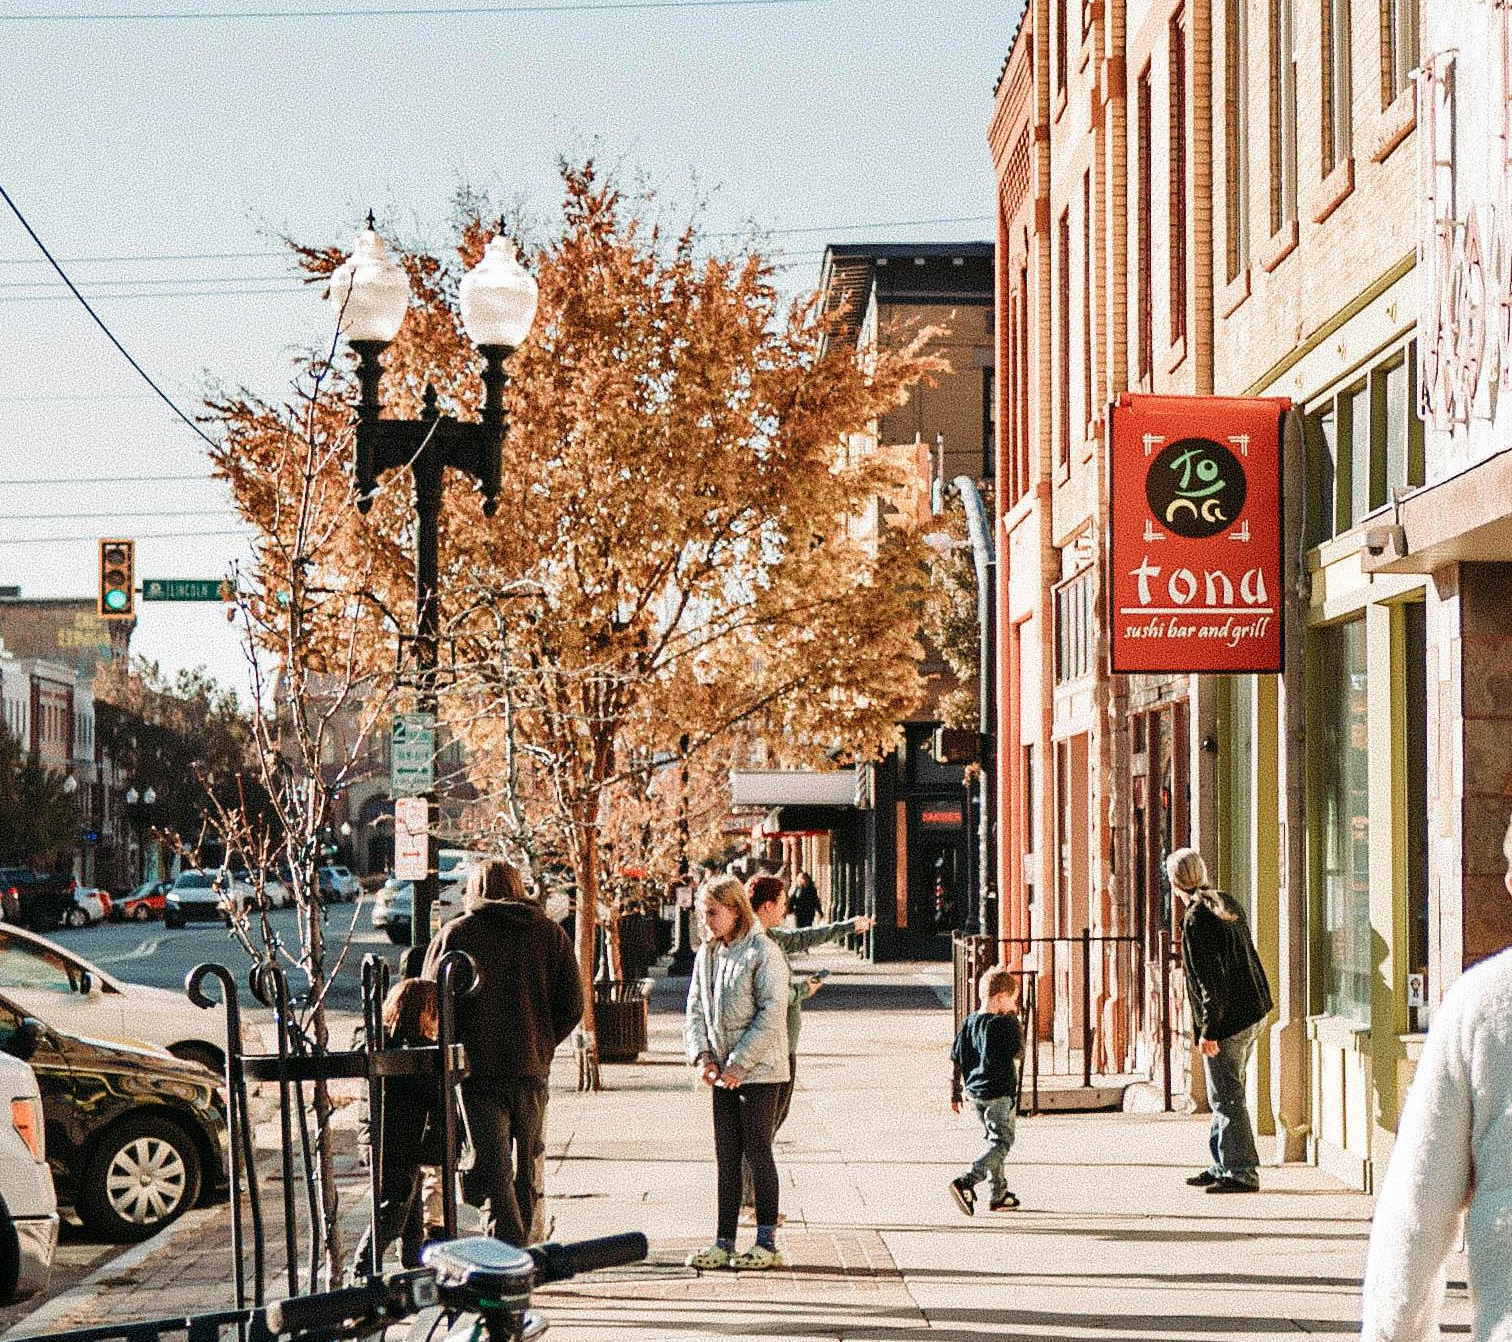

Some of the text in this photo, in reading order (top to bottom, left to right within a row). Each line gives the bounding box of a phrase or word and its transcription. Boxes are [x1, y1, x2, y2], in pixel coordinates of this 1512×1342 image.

[1128, 555, 1268, 606] tona
[1123, 616, 1270, 647] sushi bar and grill
